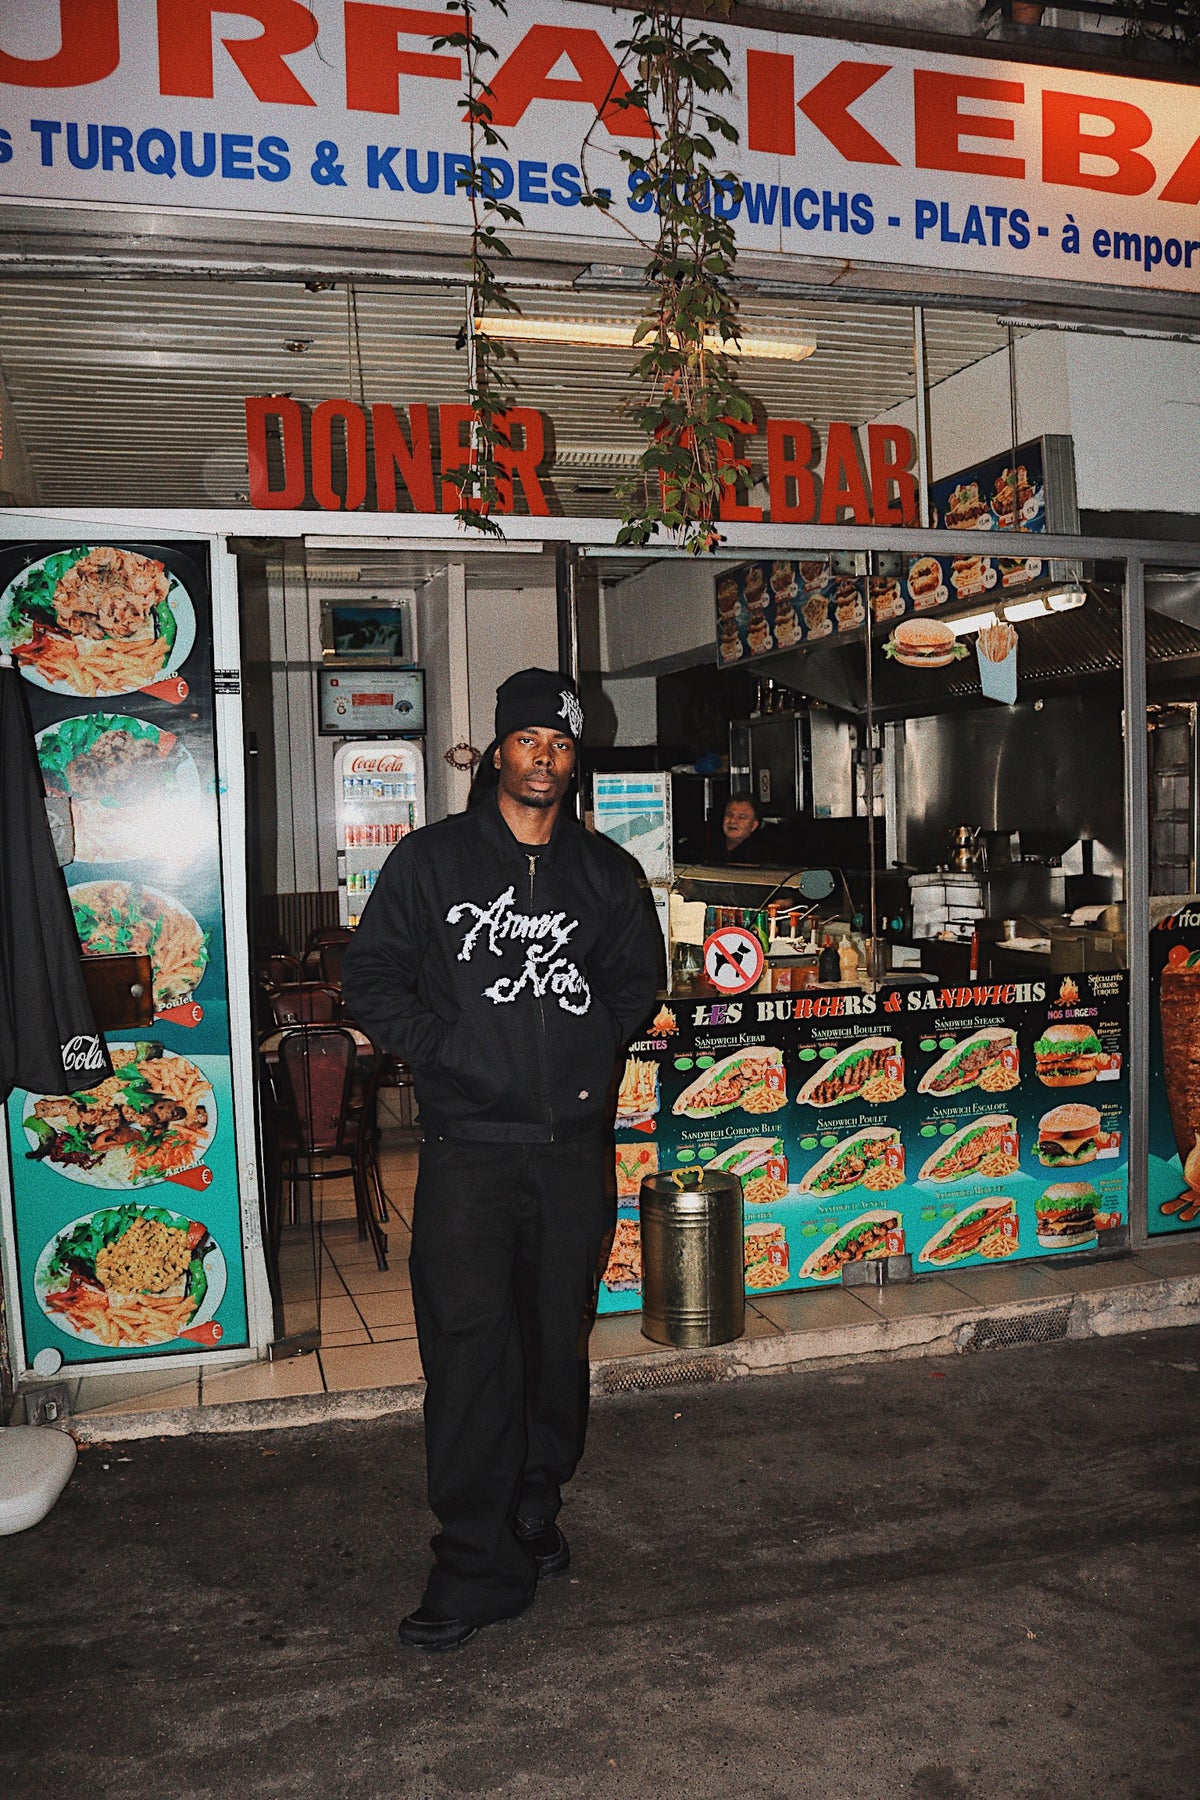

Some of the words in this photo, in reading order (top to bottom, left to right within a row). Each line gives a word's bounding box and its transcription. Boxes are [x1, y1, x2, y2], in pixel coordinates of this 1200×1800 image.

[747, 48, 1200, 205] KEB
[30, 119, 292, 183] TURQUES
[310, 140, 348, 187] &
[366, 145, 582, 207] KURDES
[915, 200, 1030, 250] PLATS
[1061, 213, 1080, 254] à
[245, 397, 550, 516] DONER
[157, 991, 194, 1012] Poulet
[691, 1002, 743, 1026] LES
[756, 993, 876, 1022] BURGERS
[907, 982, 1046, 1011] SANDWICHS
[1047, 1010, 1063, 1020] NOS
[1065, 1007, 1098, 1019] BURGERS
